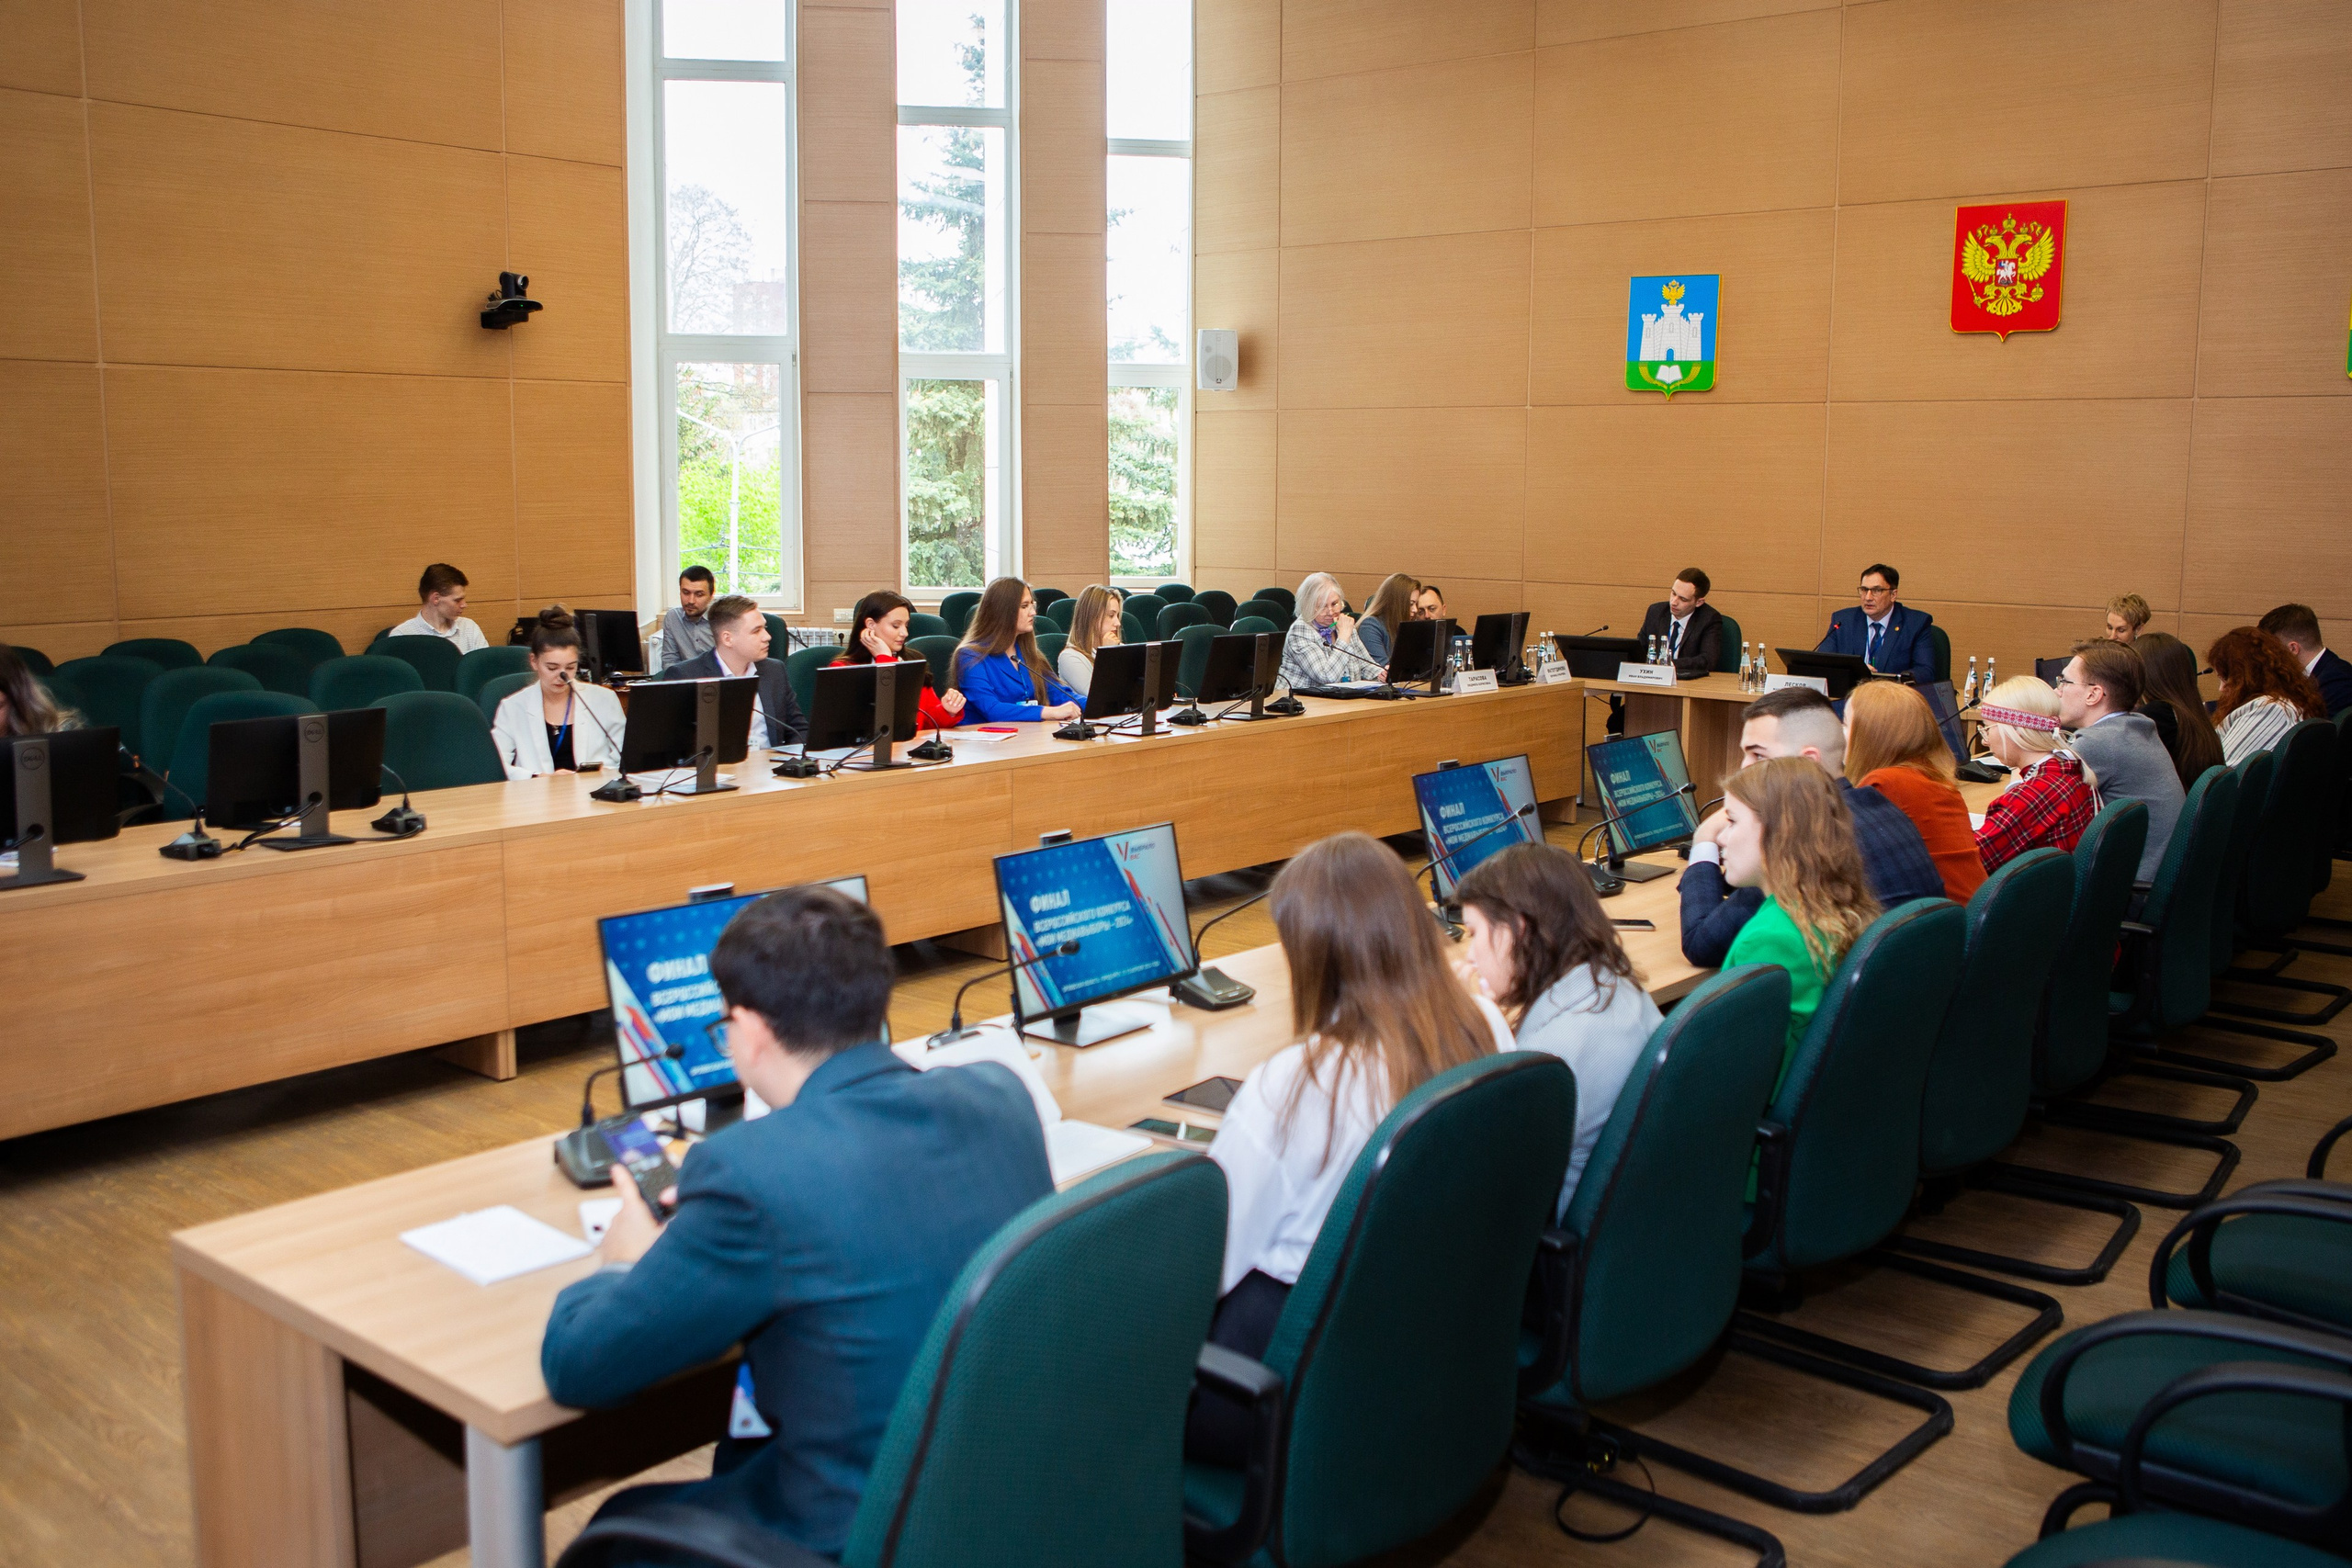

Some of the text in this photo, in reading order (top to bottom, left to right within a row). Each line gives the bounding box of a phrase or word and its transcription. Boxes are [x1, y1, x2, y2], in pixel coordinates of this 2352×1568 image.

[1610, 770, 1631, 785] ФИНАЛ
[1440, 802, 1465, 819] ФИНАЛ
[1442, 817, 1482, 835] ВСЕРОССИЙСКОГО
[1030, 888, 1071, 914] ФИНАЛ
[1033, 899, 1131, 934] ВСЕРОССИЙСКОГО КОНКУРСА
[646, 953, 709, 985] ФИНАЛ
